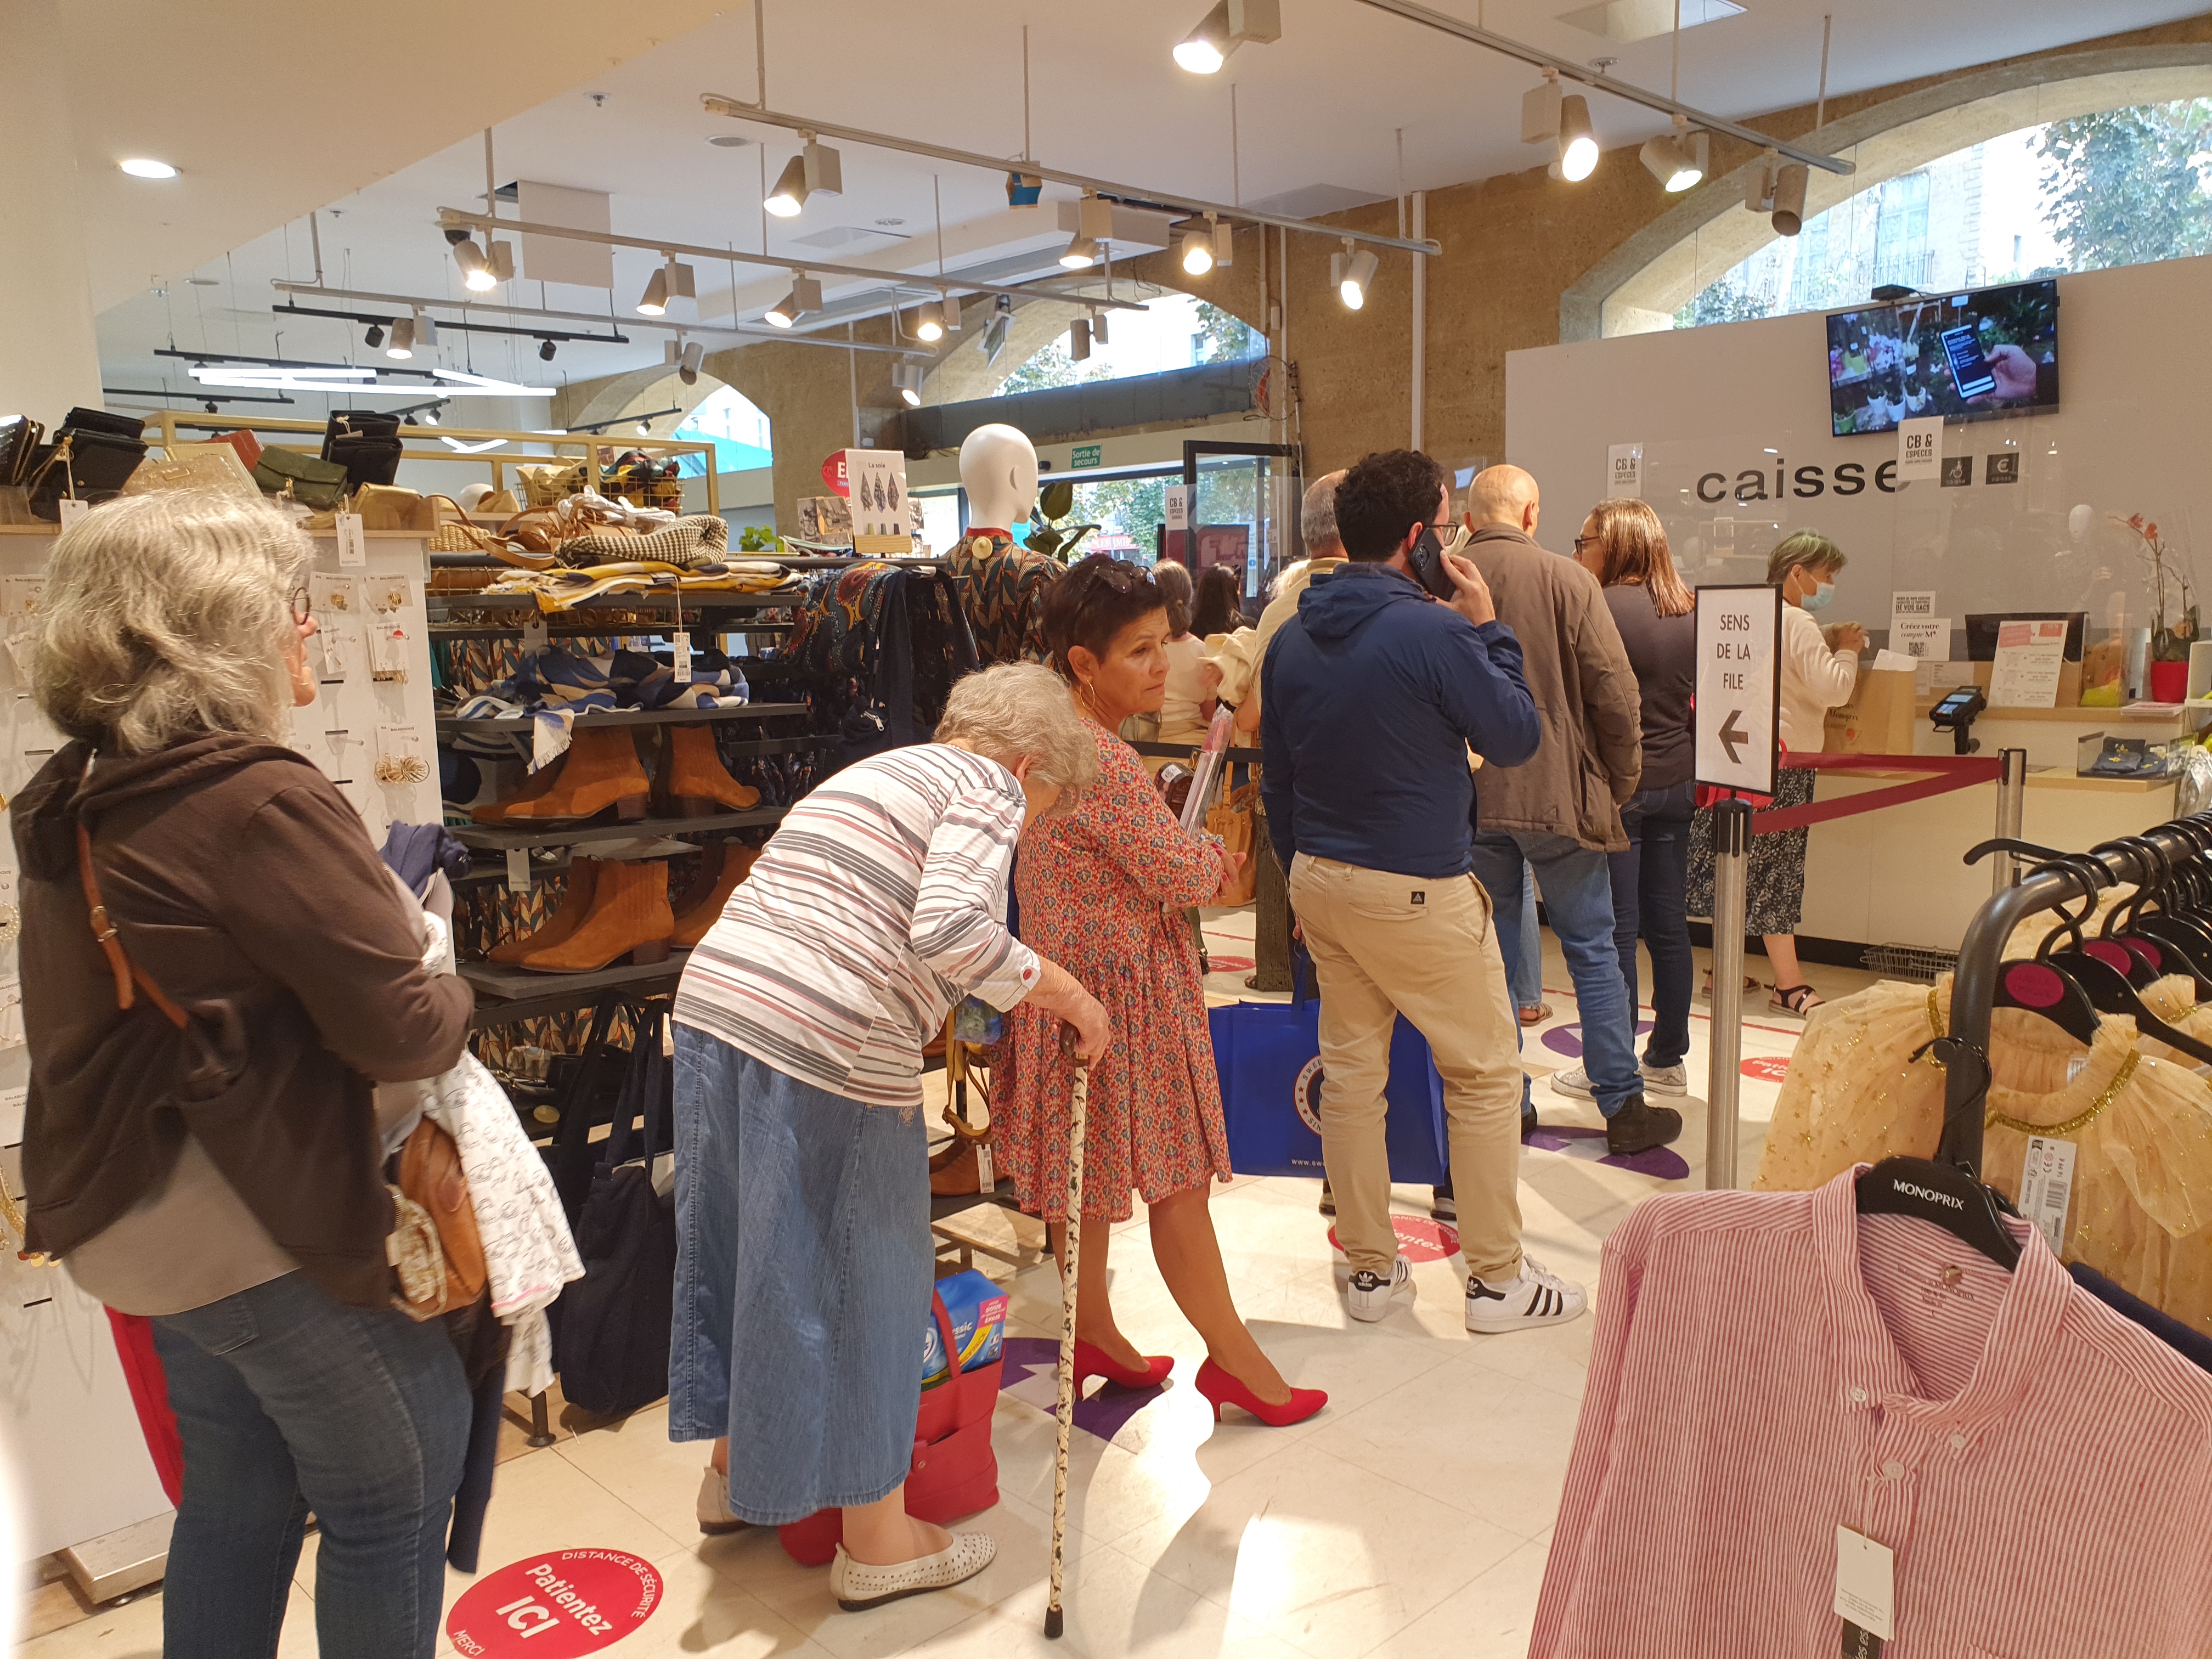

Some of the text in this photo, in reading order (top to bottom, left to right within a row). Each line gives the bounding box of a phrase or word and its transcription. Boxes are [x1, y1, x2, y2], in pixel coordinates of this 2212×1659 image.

[1906, 433, 1932, 449] CB &
[1073, 448, 1100, 459] Sortie de
[1074, 458, 1097, 466] secours
[1616, 458, 1635, 471] CB &
[1696, 458, 1911, 504] caisse
[1170, 498, 1177, 507] CB
[1719, 614, 1750, 631] SENS
[1717, 642, 1751, 661] DE LA
[1723, 673, 1743, 691] FILE
[1302, 1059, 1323, 1081] SWEE
[1760, 1067, 1787, 1077] IC
[1893, 1178, 1964, 1211] MONOPRIX
[562, 1551, 657, 1618] DISTANCE DE SÉCURITÉ
[524, 1562, 613, 1637] Patientez
[495, 1595, 560, 1639] ICI
[453, 1629, 486, 1657] MERCI
